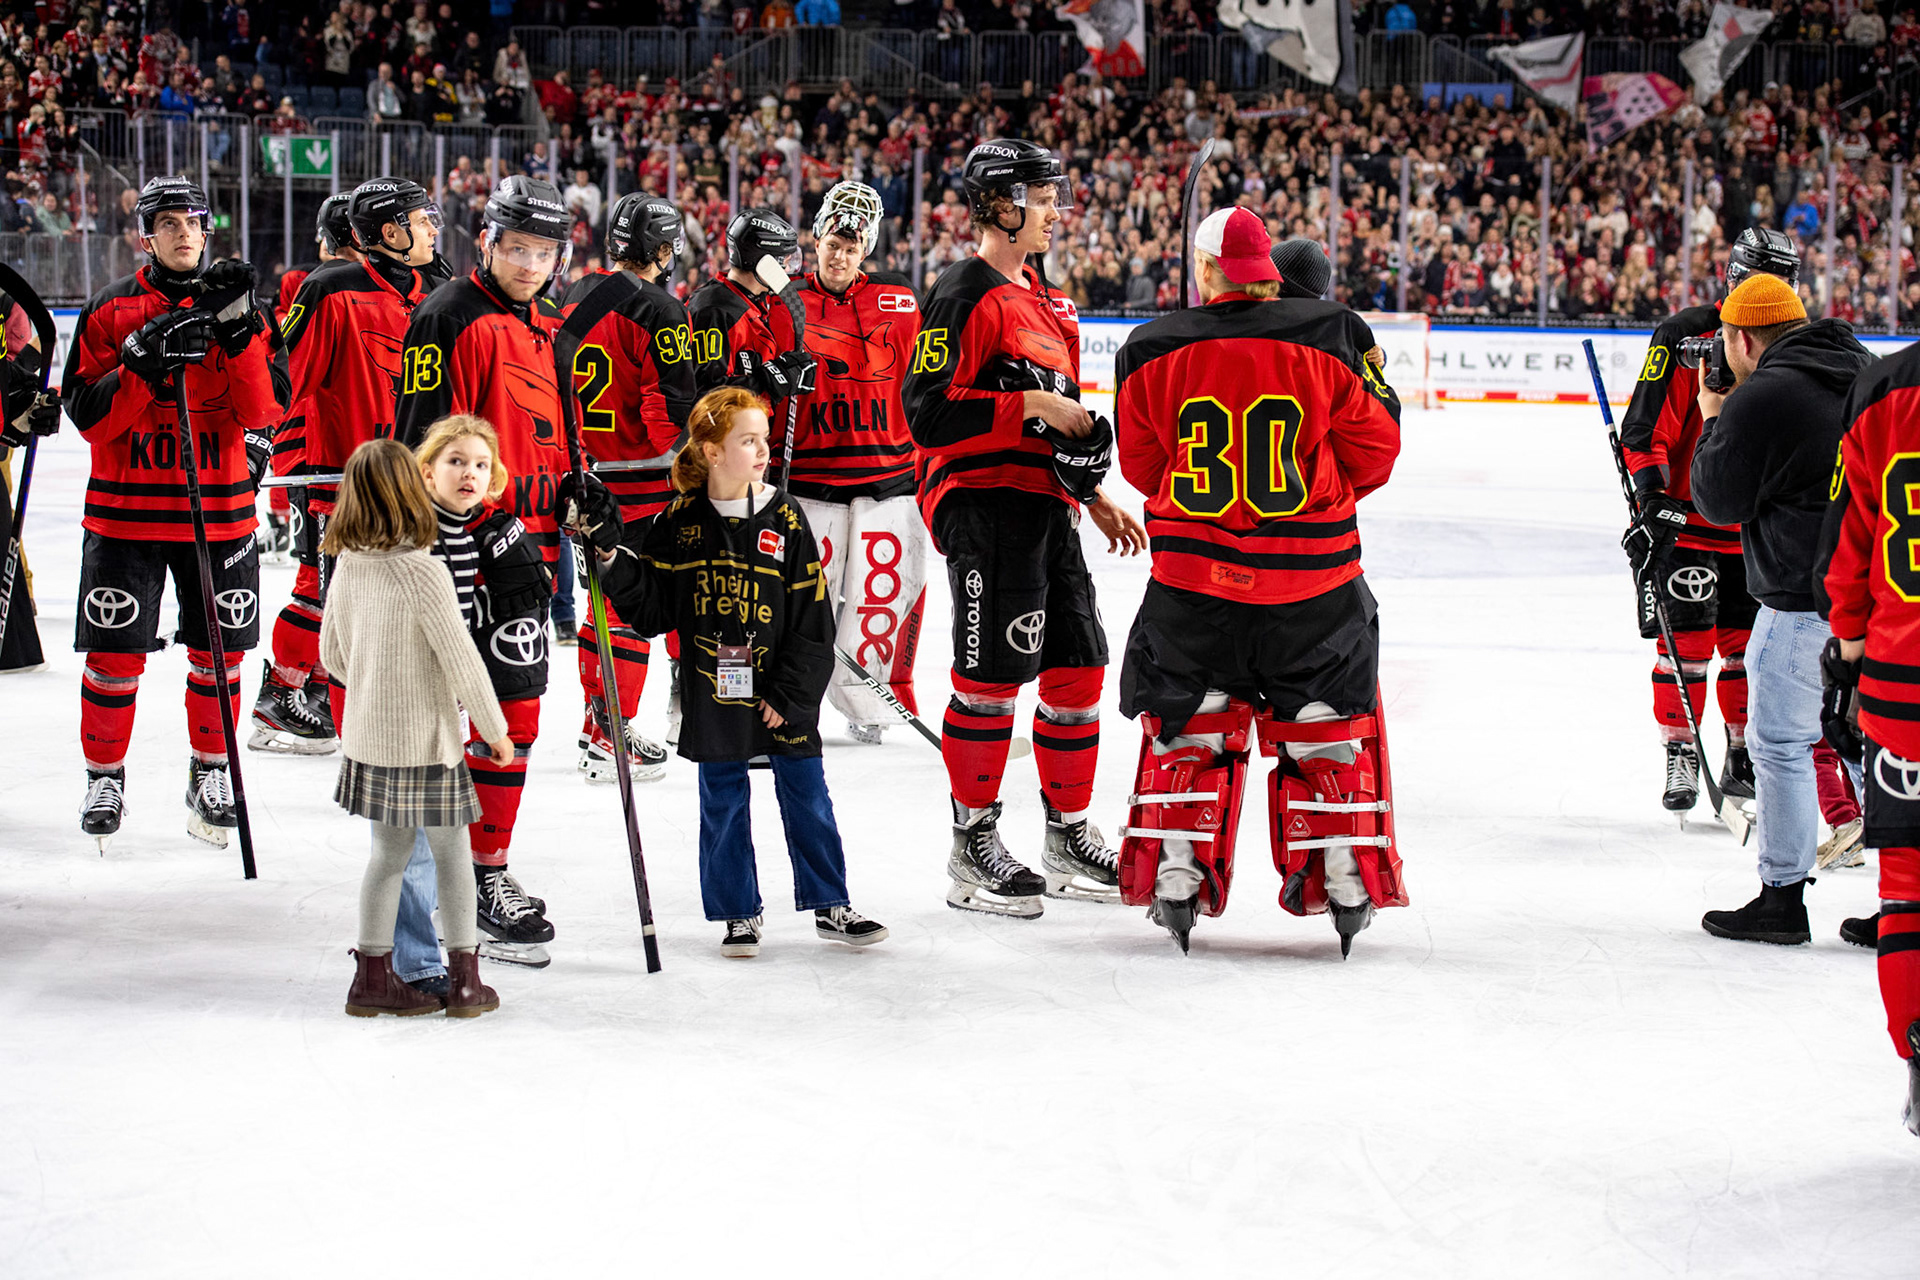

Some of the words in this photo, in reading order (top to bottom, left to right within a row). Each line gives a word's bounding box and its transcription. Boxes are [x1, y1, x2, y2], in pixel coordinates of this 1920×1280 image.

[972, 145, 1018, 160] STETSON
[986, 168, 1014, 176] BAUER
[356, 183, 399, 194] STETSON
[372, 199, 396, 210] BAUER
[527, 197, 564, 212] STETSON
[646, 204, 676, 216] STETSON
[531, 213, 561, 224] BAUER
[617, 216, 630, 228] 92
[751, 217, 788, 237] STETSON
[612, 228, 631, 239] STETSON
[655, 324, 692, 364] 92
[692, 327, 723, 364] 10
[913, 327, 949, 374] 15
[403, 343, 442, 395] 13
[739, 351, 753, 375] BAU
[761, 360, 788, 385] BAU
[811, 393, 889, 435] KÖLN
[245, 432, 274, 454] BAU
[1170, 394, 1308, 518] 30
[514, 464, 559, 517] KÖ
[1656, 509, 1688, 525] BAU
[492, 516, 526, 559] BAU
[1644, 580, 1655, 623] YOTA
[903, 611, 920, 668] BAUER
[966, 600, 981, 669] TOYOTA
[209, 621, 225, 687] HYPERLITE
[863, 677, 915, 721] BAUER
